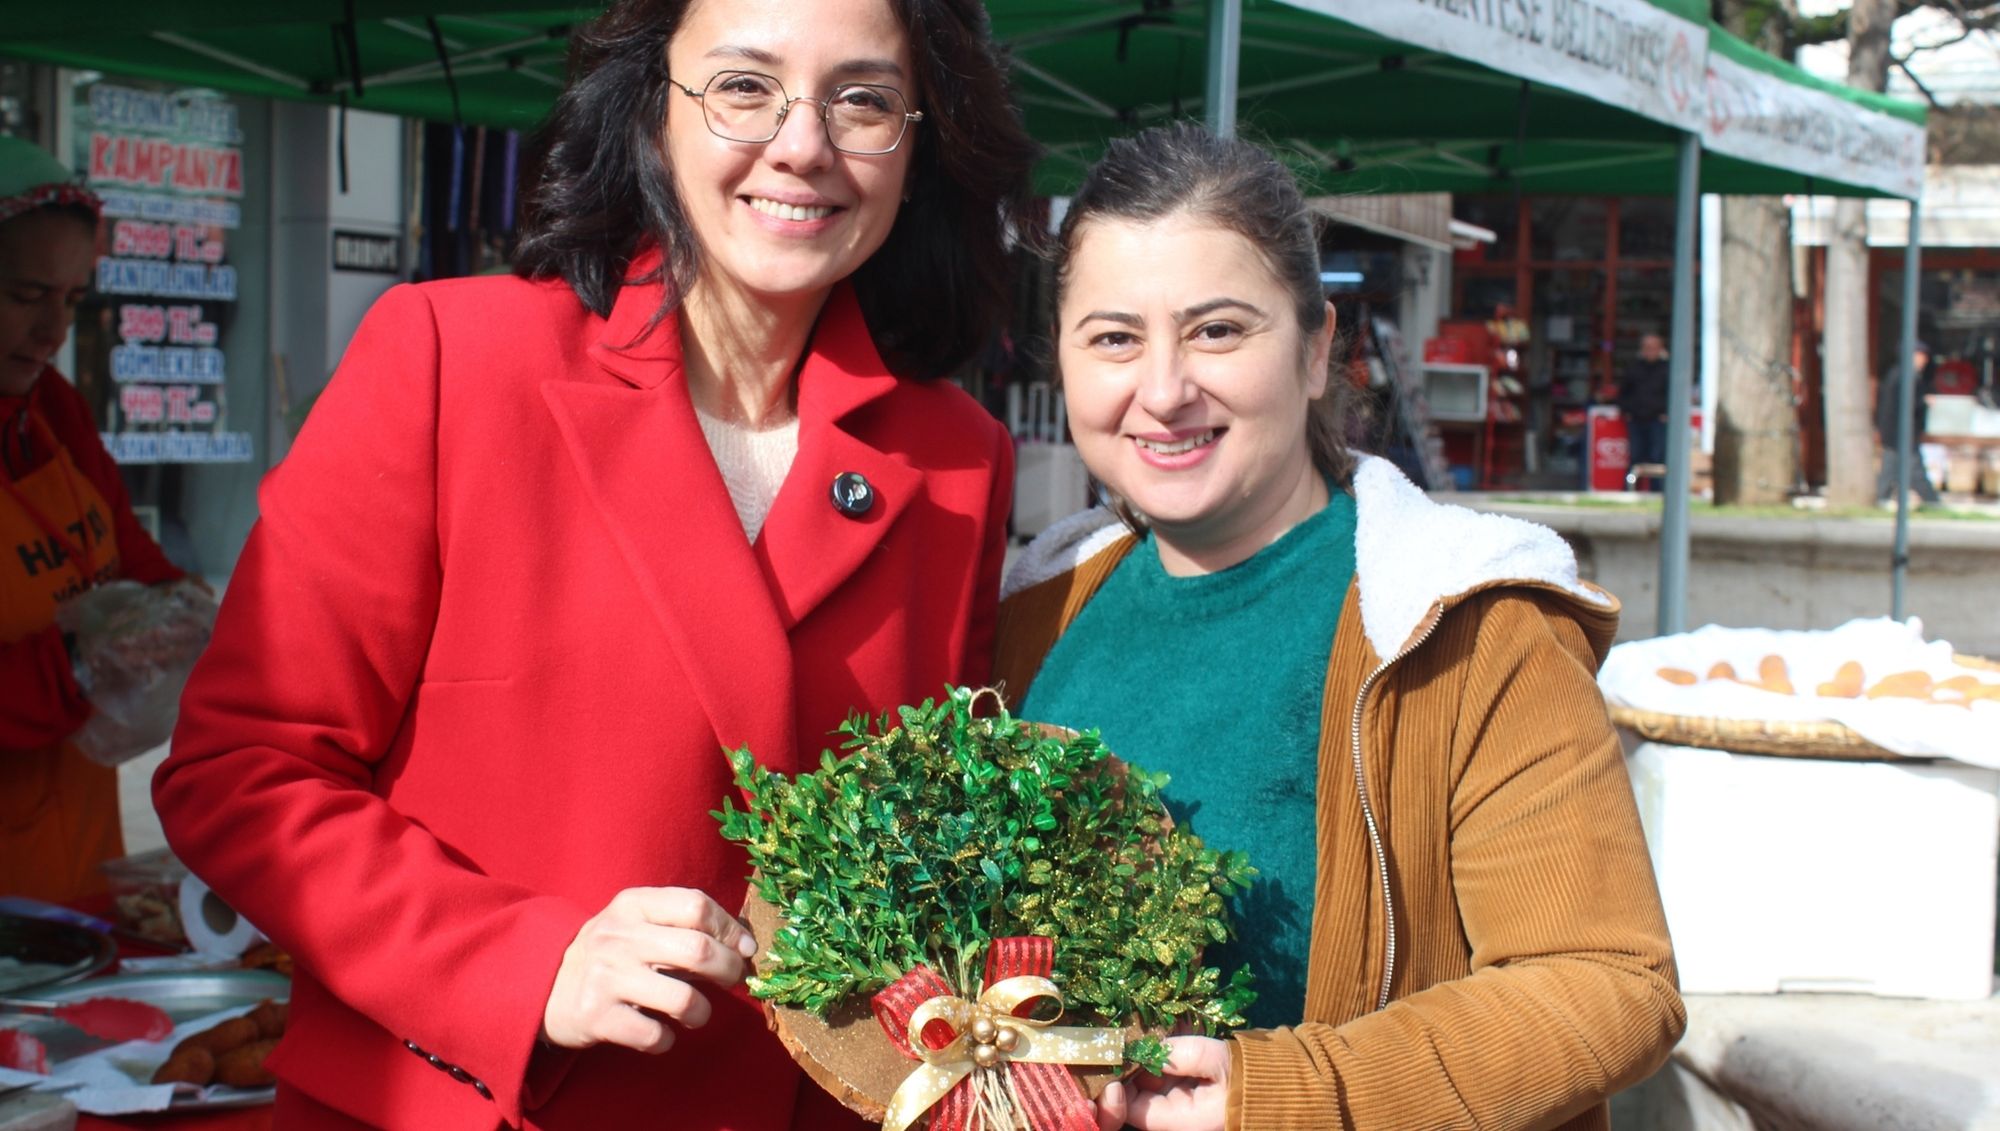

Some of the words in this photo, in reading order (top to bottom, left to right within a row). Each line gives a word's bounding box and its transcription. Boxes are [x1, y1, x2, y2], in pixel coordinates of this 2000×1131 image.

[93, 134, 242, 193] KAMPANYA
[98, 257, 236, 299] PANTOLONLAR
[112, 342, 224, 381] GÖMLEKLER
